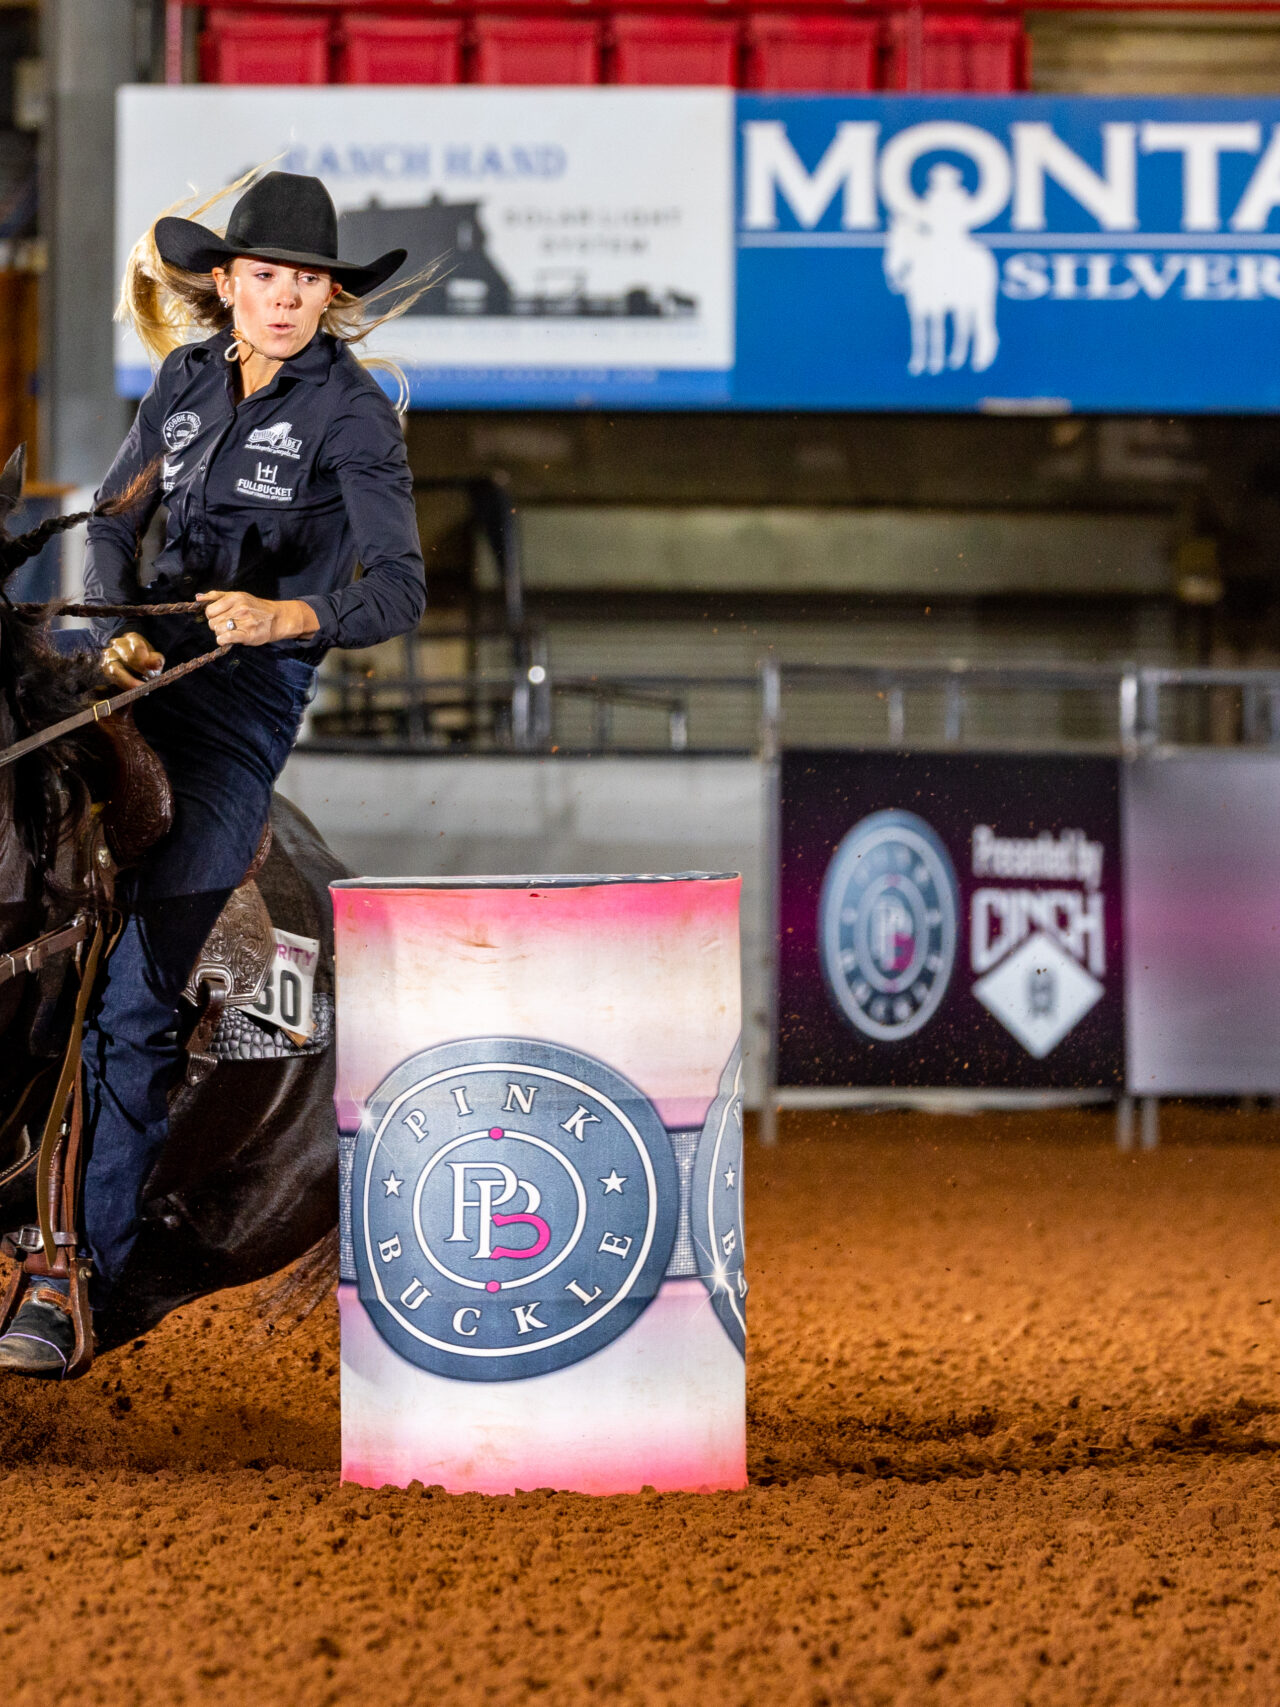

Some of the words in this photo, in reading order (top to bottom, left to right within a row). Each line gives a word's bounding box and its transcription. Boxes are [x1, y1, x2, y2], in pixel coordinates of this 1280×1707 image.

[444, 143, 568, 179] HAND
[238, 478, 292, 497] FULLBUCKET
[276, 943, 315, 966] RITY
[401, 1083, 604, 1142] PINK
[378, 1230, 633, 1336] BUCKLE
